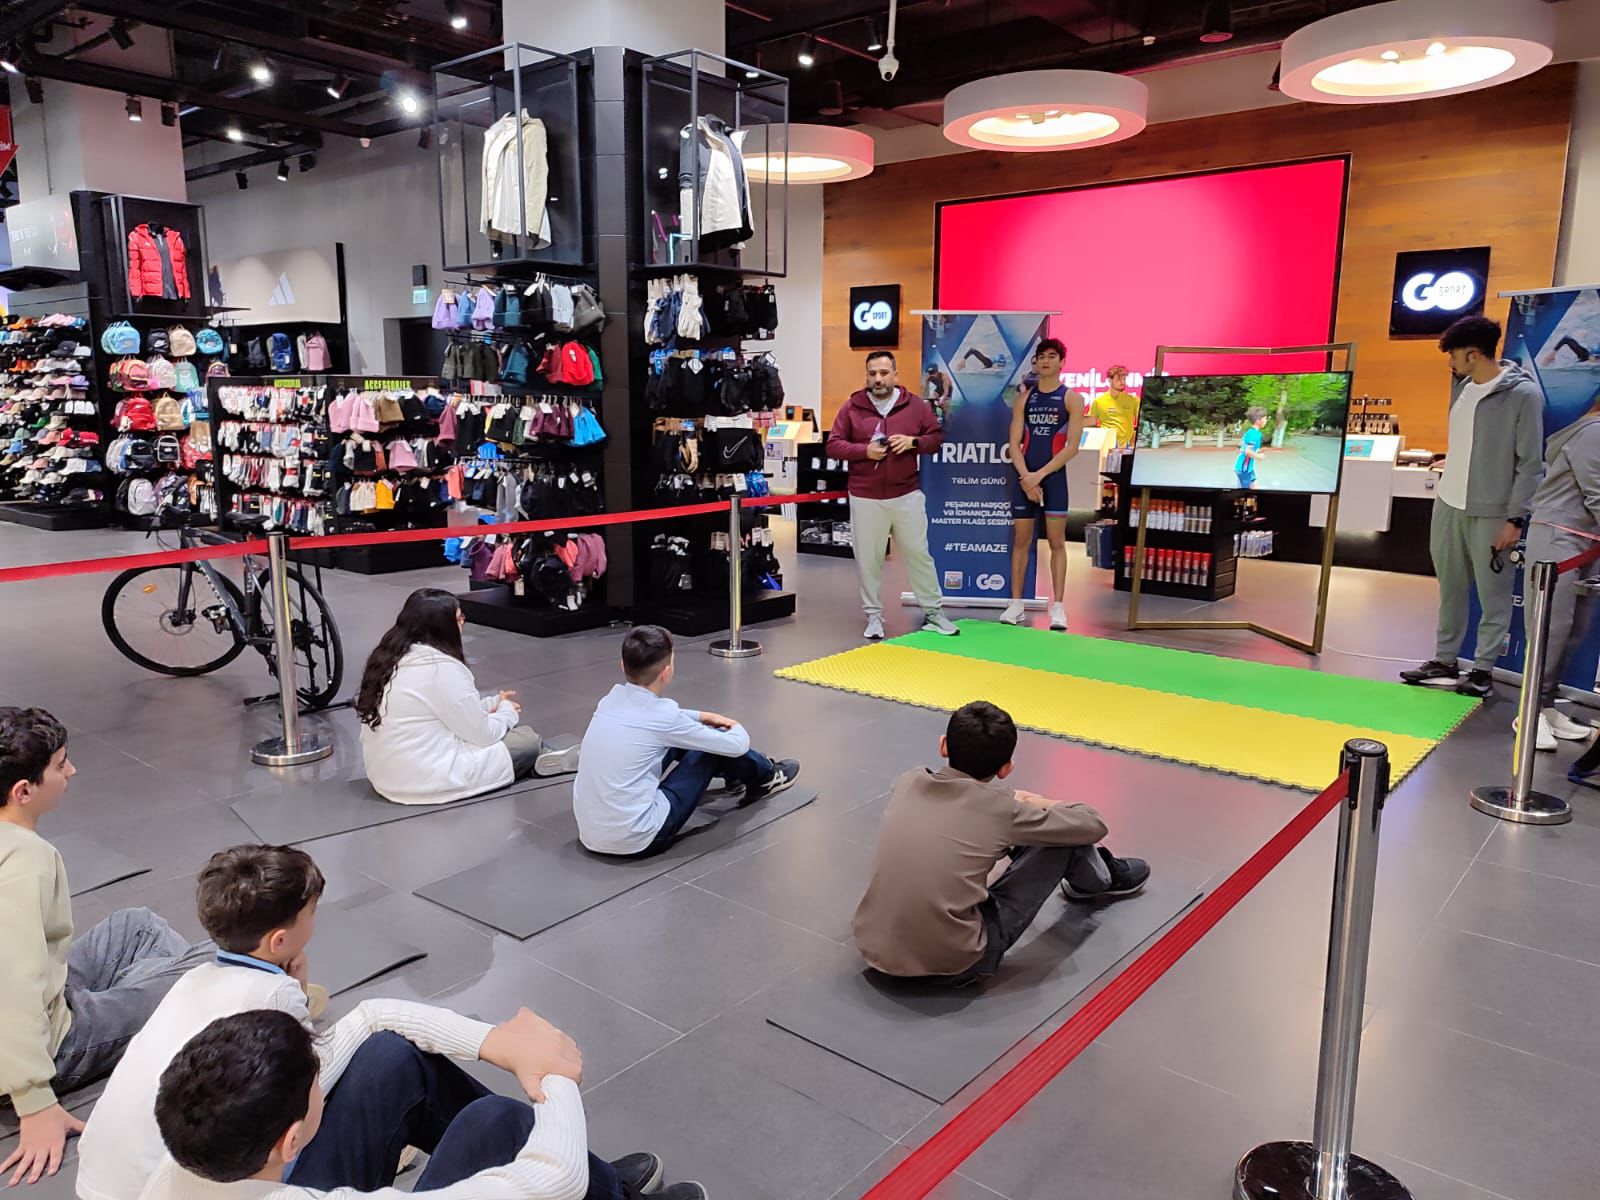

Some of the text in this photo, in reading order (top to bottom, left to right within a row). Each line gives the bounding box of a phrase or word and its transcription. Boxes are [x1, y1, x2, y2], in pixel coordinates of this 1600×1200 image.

[1402, 271, 1475, 311] GO
[853, 301, 892, 330] GO
[1032, 426, 1051, 436] AZE
[980, 476, 1007, 485] GÜNÜ
[944, 543, 1008, 553] #TEAMAZE
[976, 573, 1005, 591] GO
